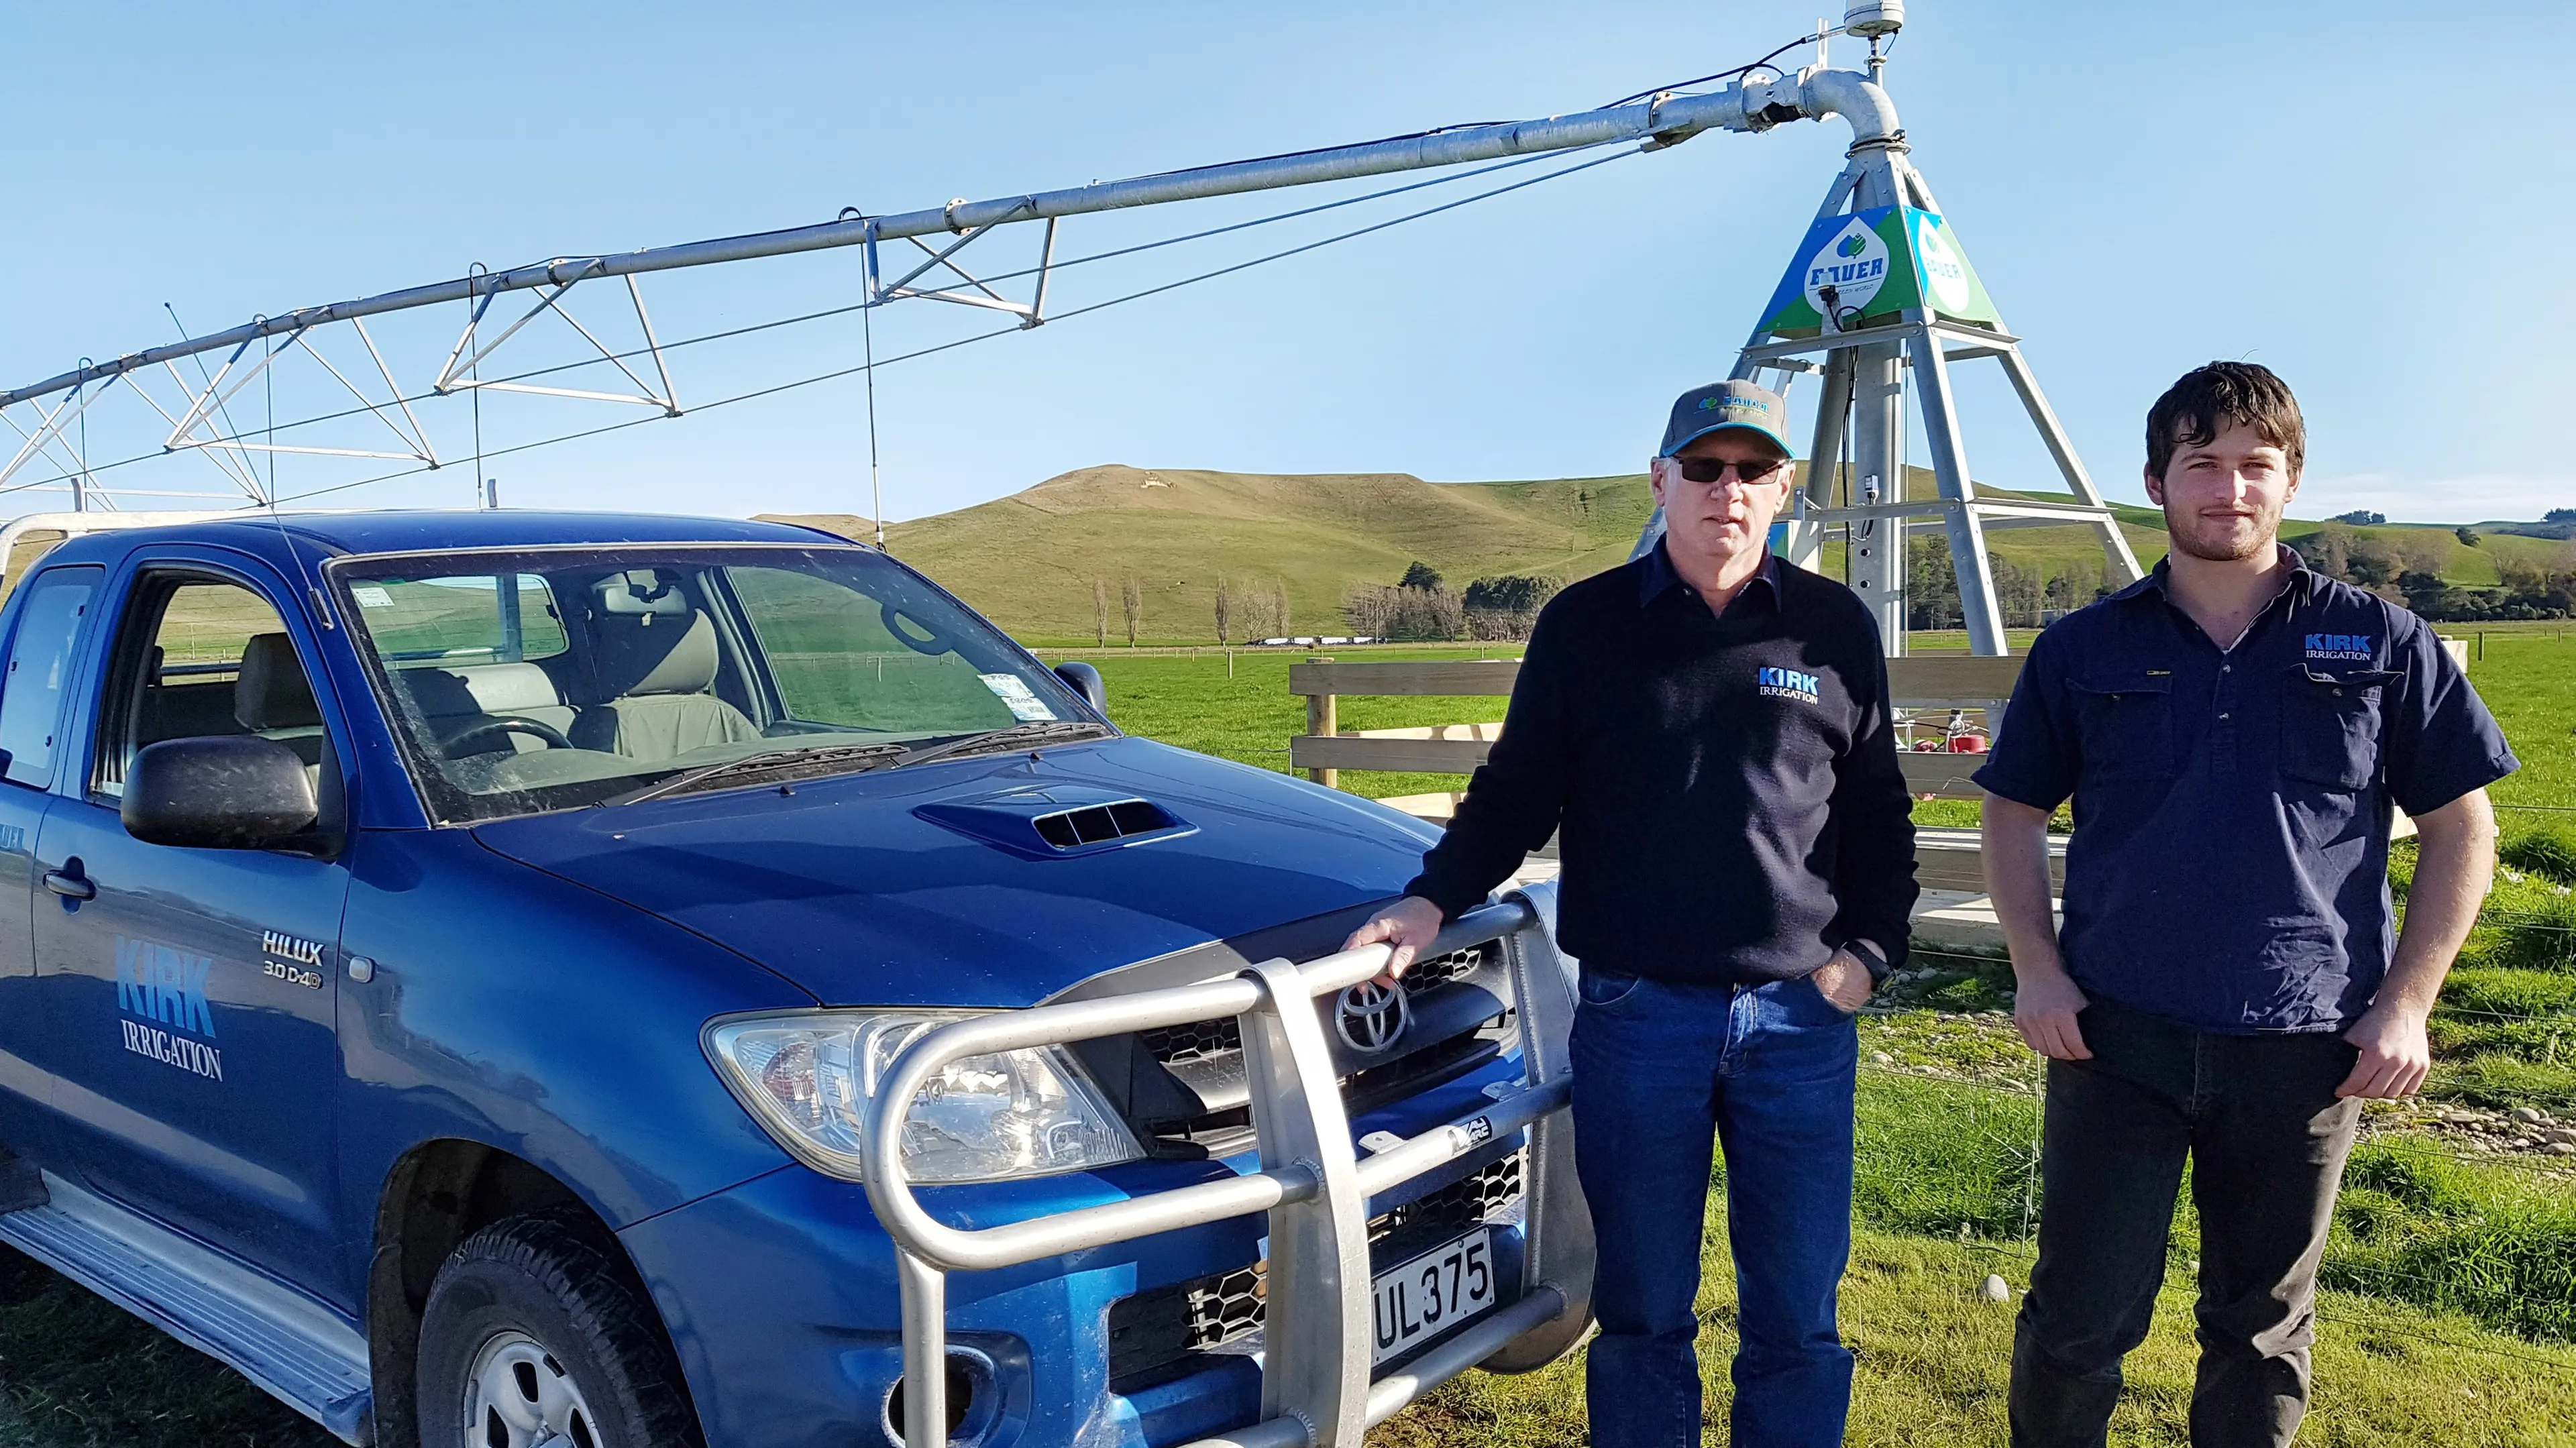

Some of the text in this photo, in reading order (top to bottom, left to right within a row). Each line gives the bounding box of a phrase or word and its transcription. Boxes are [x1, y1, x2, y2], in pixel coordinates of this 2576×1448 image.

[2305, 633, 2371, 653] KIRK
[2306, 650, 2371, 661] IRRIGATION
[1759, 667, 1820, 696] KIRK
[1760, 686, 1819, 705] IRRIGATION
[262, 930, 324, 966] HILUX
[115, 936, 217, 1039] KIRK
[121, 1018, 223, 1082] IRRIGATION
